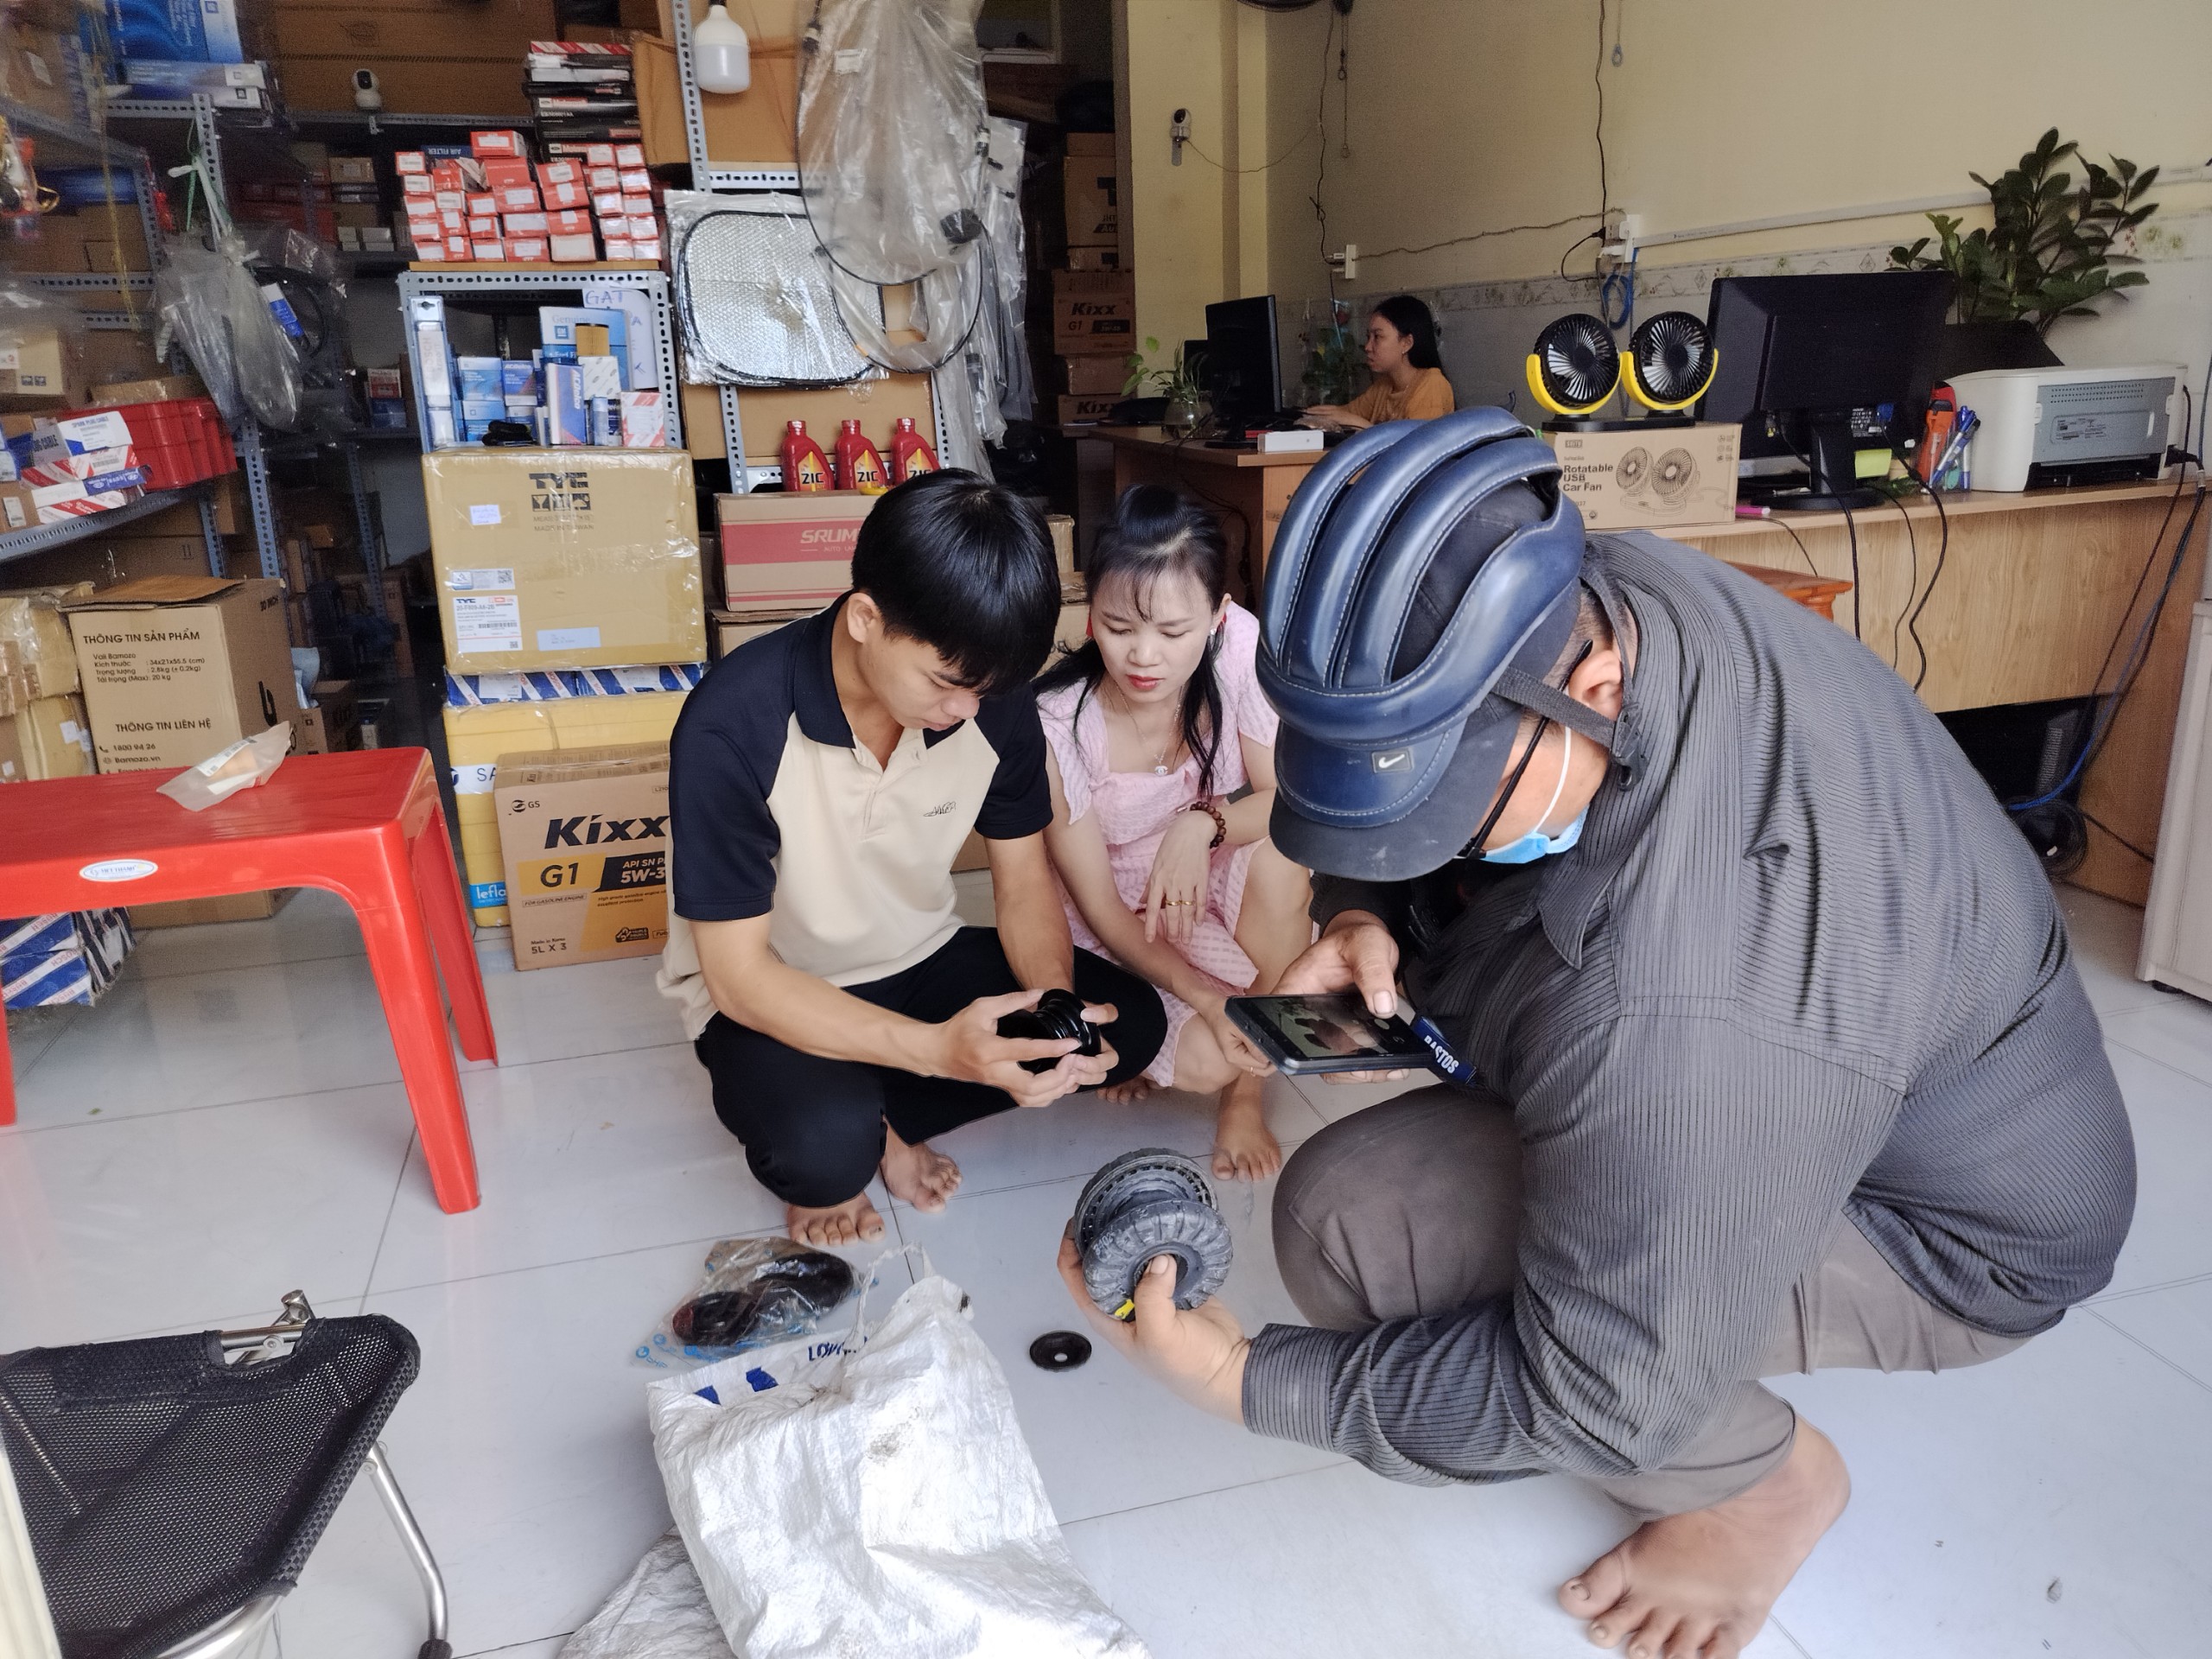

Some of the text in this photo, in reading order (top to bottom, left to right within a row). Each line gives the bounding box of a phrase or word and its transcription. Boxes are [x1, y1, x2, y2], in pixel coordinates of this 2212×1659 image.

[1071, 302, 1117, 316] Kixx
[551, 315, 591, 324] Genuine
[1068, 321, 1083, 332] G1
[1563, 463, 1613, 474] Rotatable
[802, 472, 824, 485] ZIC
[856, 470, 879, 482] ZIC
[1563, 474, 1586, 483] USB
[1562, 481, 1603, 493] Car Fan
[83, 627, 200, 645] THÔNG TIN SẢN PHẨM
[116, 717, 212, 733] THÔNG TIN LIÊN HỆ
[113, 743, 132, 752] 1800
[146, 742, 156, 751] 26
[115, 755, 162, 764] Bamozo.vn
[527, 800, 541, 809] GS
[544, 813, 671, 850] Kixx
[622, 859, 641, 869] API
[642, 858, 657, 868] SN
[540, 861, 580, 887] G1
[531, 942, 567, 955] 5L X 3
